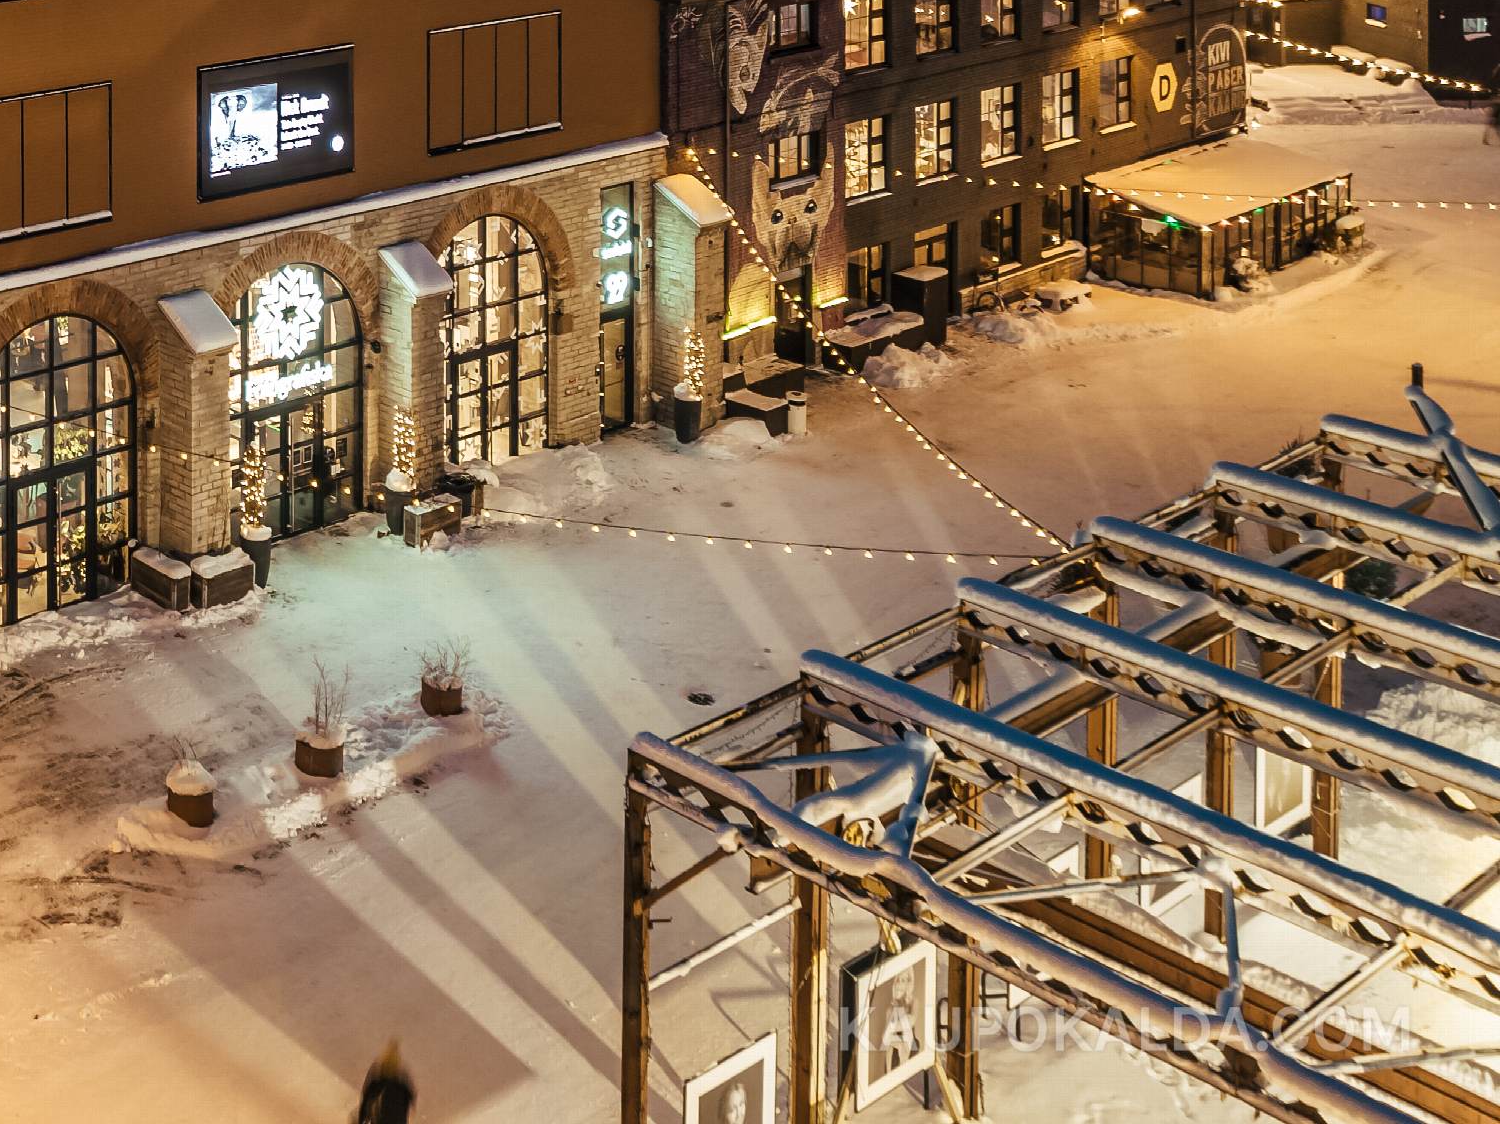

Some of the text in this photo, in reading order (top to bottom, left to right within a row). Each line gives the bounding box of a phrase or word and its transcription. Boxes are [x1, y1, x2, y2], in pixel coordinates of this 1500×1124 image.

[1208, 40, 1230, 66] KIVI
[1159, 75, 1171, 101] D
[1208, 65, 1243, 93] PABER
